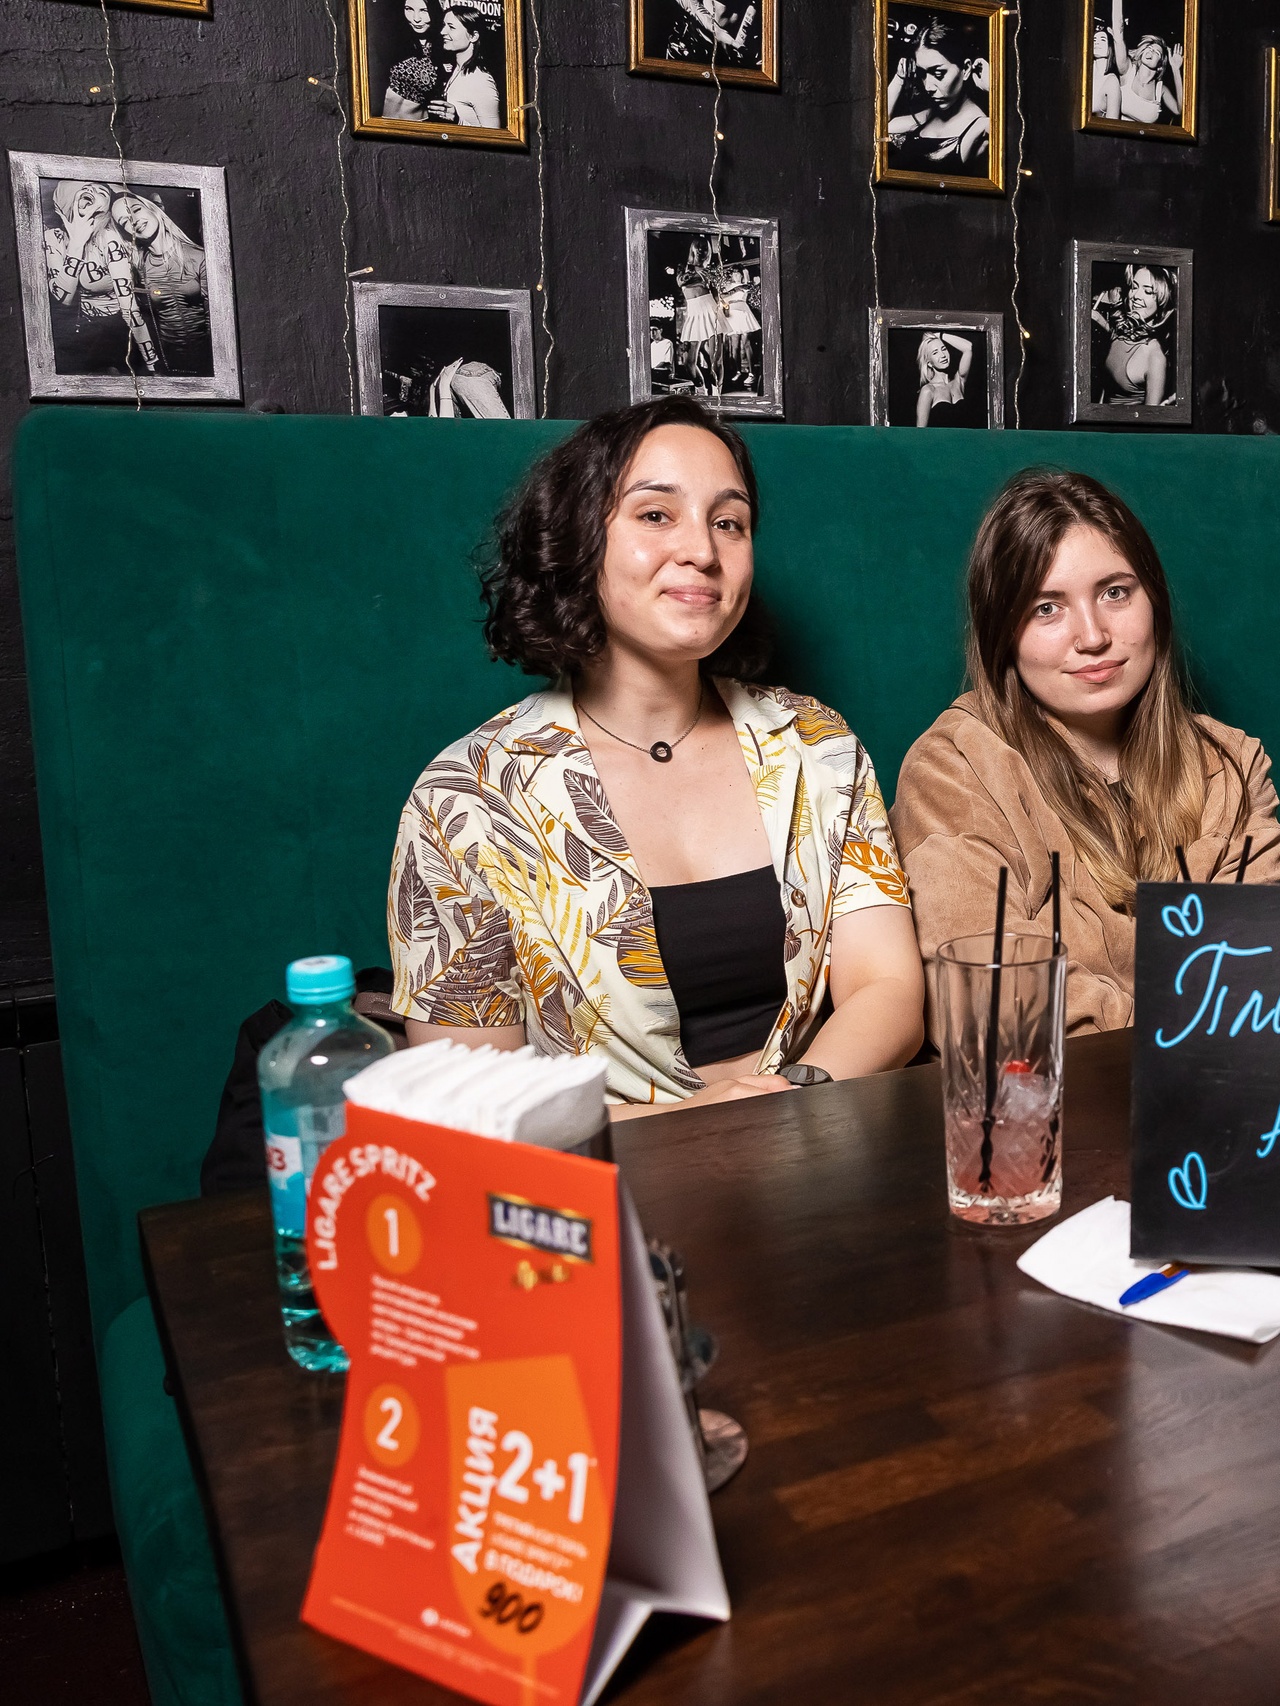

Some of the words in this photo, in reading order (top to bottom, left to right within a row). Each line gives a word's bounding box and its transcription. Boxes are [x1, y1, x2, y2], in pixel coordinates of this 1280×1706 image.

[349, 1143, 437, 1202] SPRITZ
[384, 1208, 400, 1257] 1
[376, 1397, 403, 1451] 2
[451, 1406, 498, 1574] АКЦИЯ
[479, 1581, 544, 1635] 900
